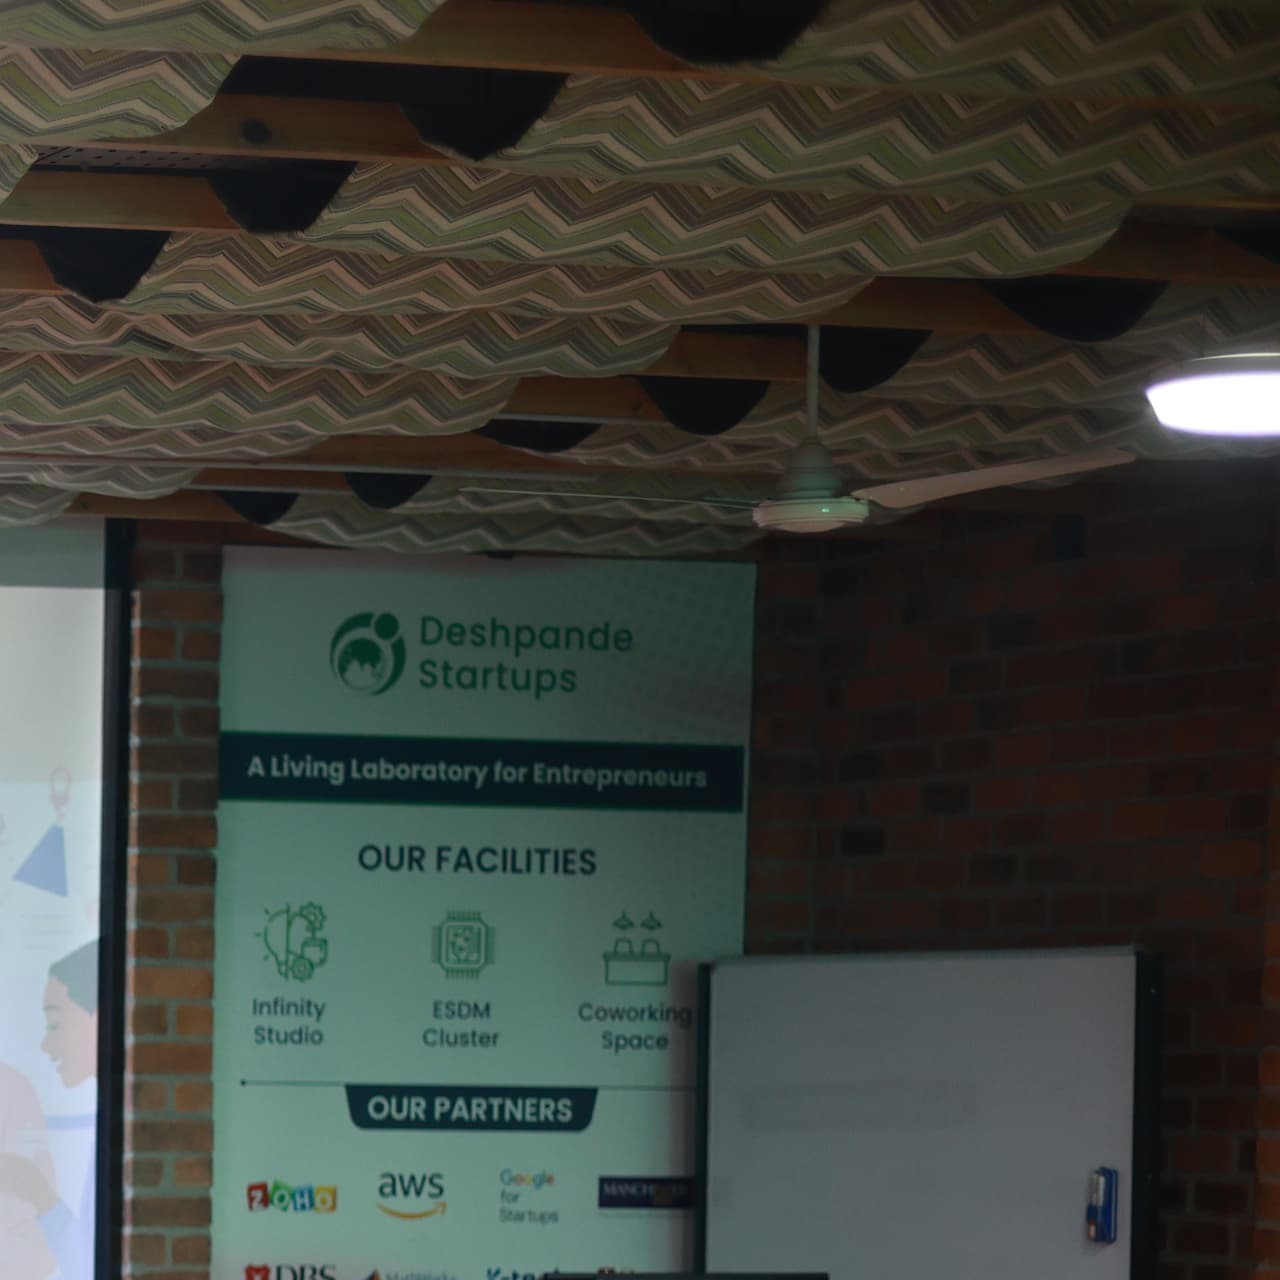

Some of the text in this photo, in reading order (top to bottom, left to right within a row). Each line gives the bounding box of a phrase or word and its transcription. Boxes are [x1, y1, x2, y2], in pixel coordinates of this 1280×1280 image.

[419, 616, 634, 657] Deshpande
[418, 659, 578, 699] Startups
[247, 755, 707, 792] A Living Laboratory for Entrepreneurs
[357, 845, 598, 876] OUR FACILITIES
[252, 997, 326, 1023] Infinity
[432, 1001, 491, 1020] ESDM
[578, 1002, 693, 1030] Coworking
[253, 1024, 324, 1047] Studio
[422, 1027, 500, 1049] Cluster
[601, 1030, 669, 1054] Space
[367, 1095, 573, 1123] OUR PARTNERS
[378, 1171, 445, 1199] aws
[499, 1168, 556, 1191] Google
[247, 1180, 338, 1213] ZOHO
[499, 1206, 559, 1226] Startups
